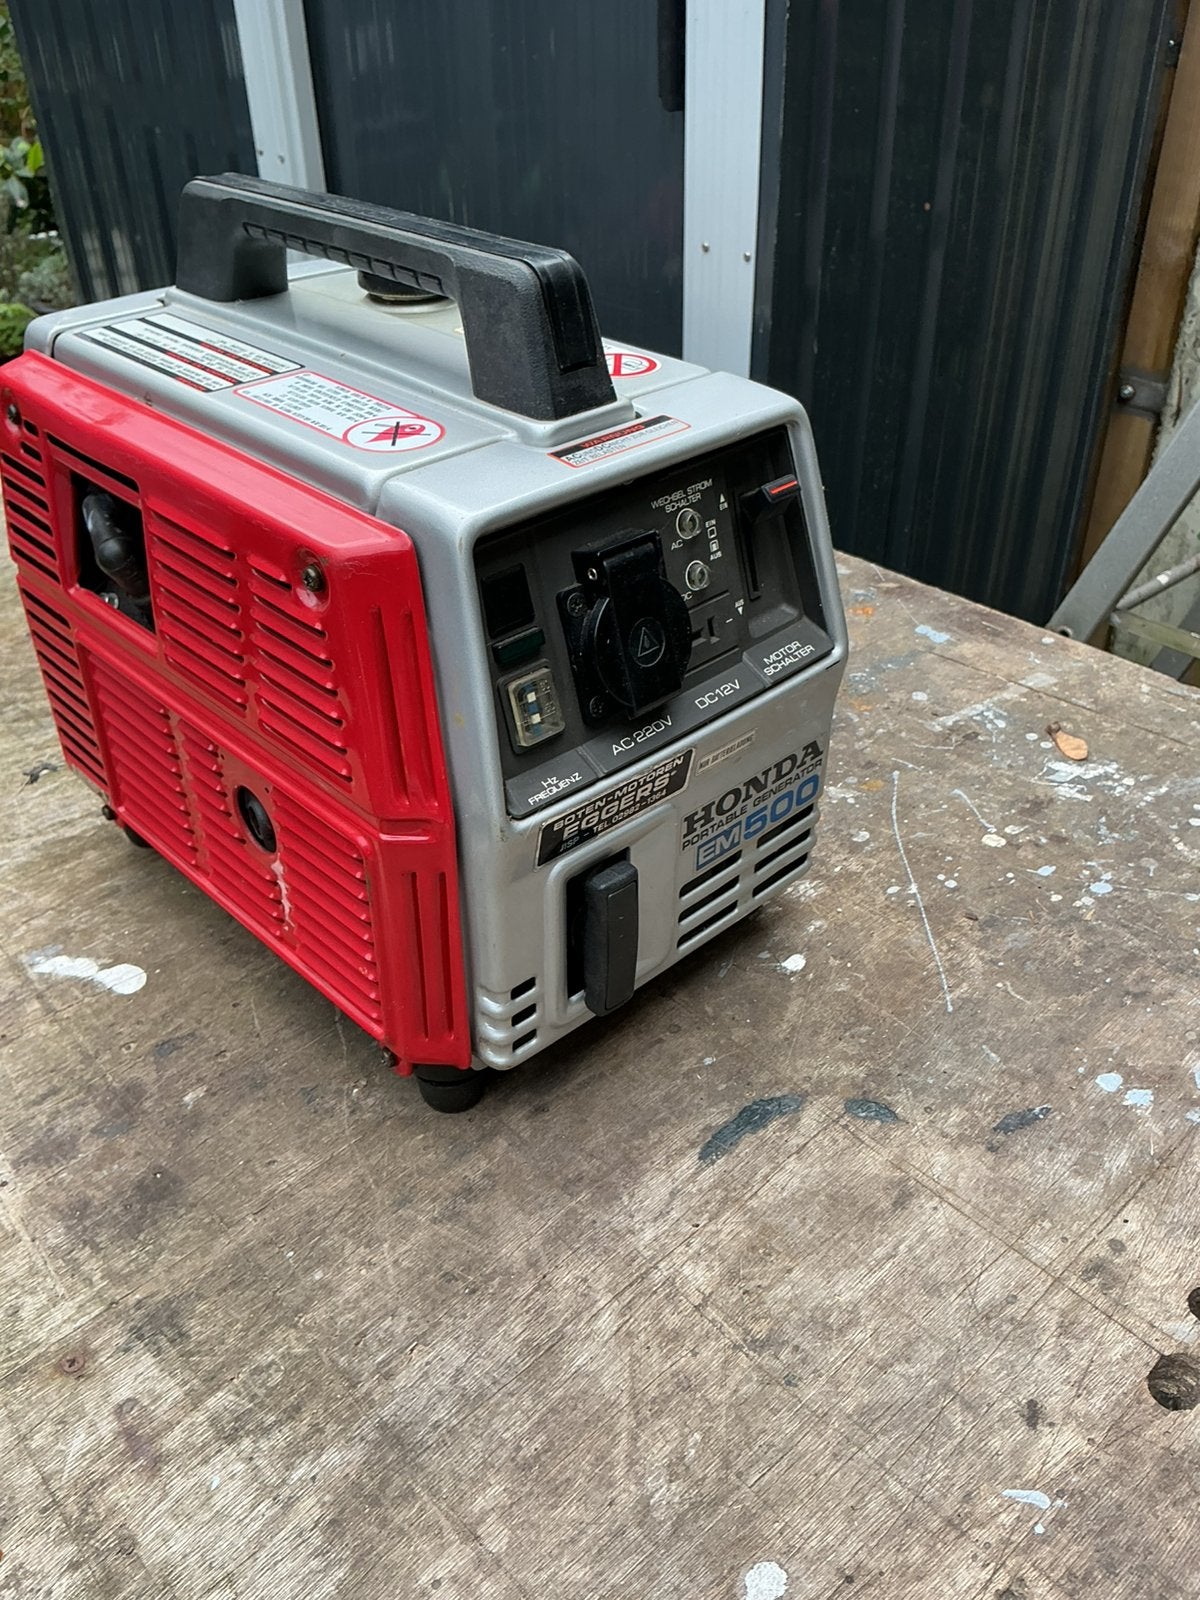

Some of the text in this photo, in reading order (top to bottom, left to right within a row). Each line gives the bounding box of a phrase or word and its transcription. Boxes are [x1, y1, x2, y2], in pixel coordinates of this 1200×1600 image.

[581, 424, 645, 449] WARNUNG
[651, 478, 713, 509] WECHSEL STROM
[664, 492, 702, 514] SCHALTER
[705, 519, 716, 528] EIN
[670, 539, 684, 551] AC
[710, 550, 722, 561] AUS
[763, 640, 802, 666] MOTOR
[763, 644, 815, 676] SCHALTER
[694, 679, 741, 710] DC12V
[611, 715, 673, 756] AC 220V
[528, 772, 583, 806] FREQUENZ
[541, 776, 560, 789] Hz
[553, 755, 685, 832] BOTEN-MOTOREN
[682, 740, 824, 840] HONDA
[681, 758, 823, 851] PORTABLE GENERATOR
